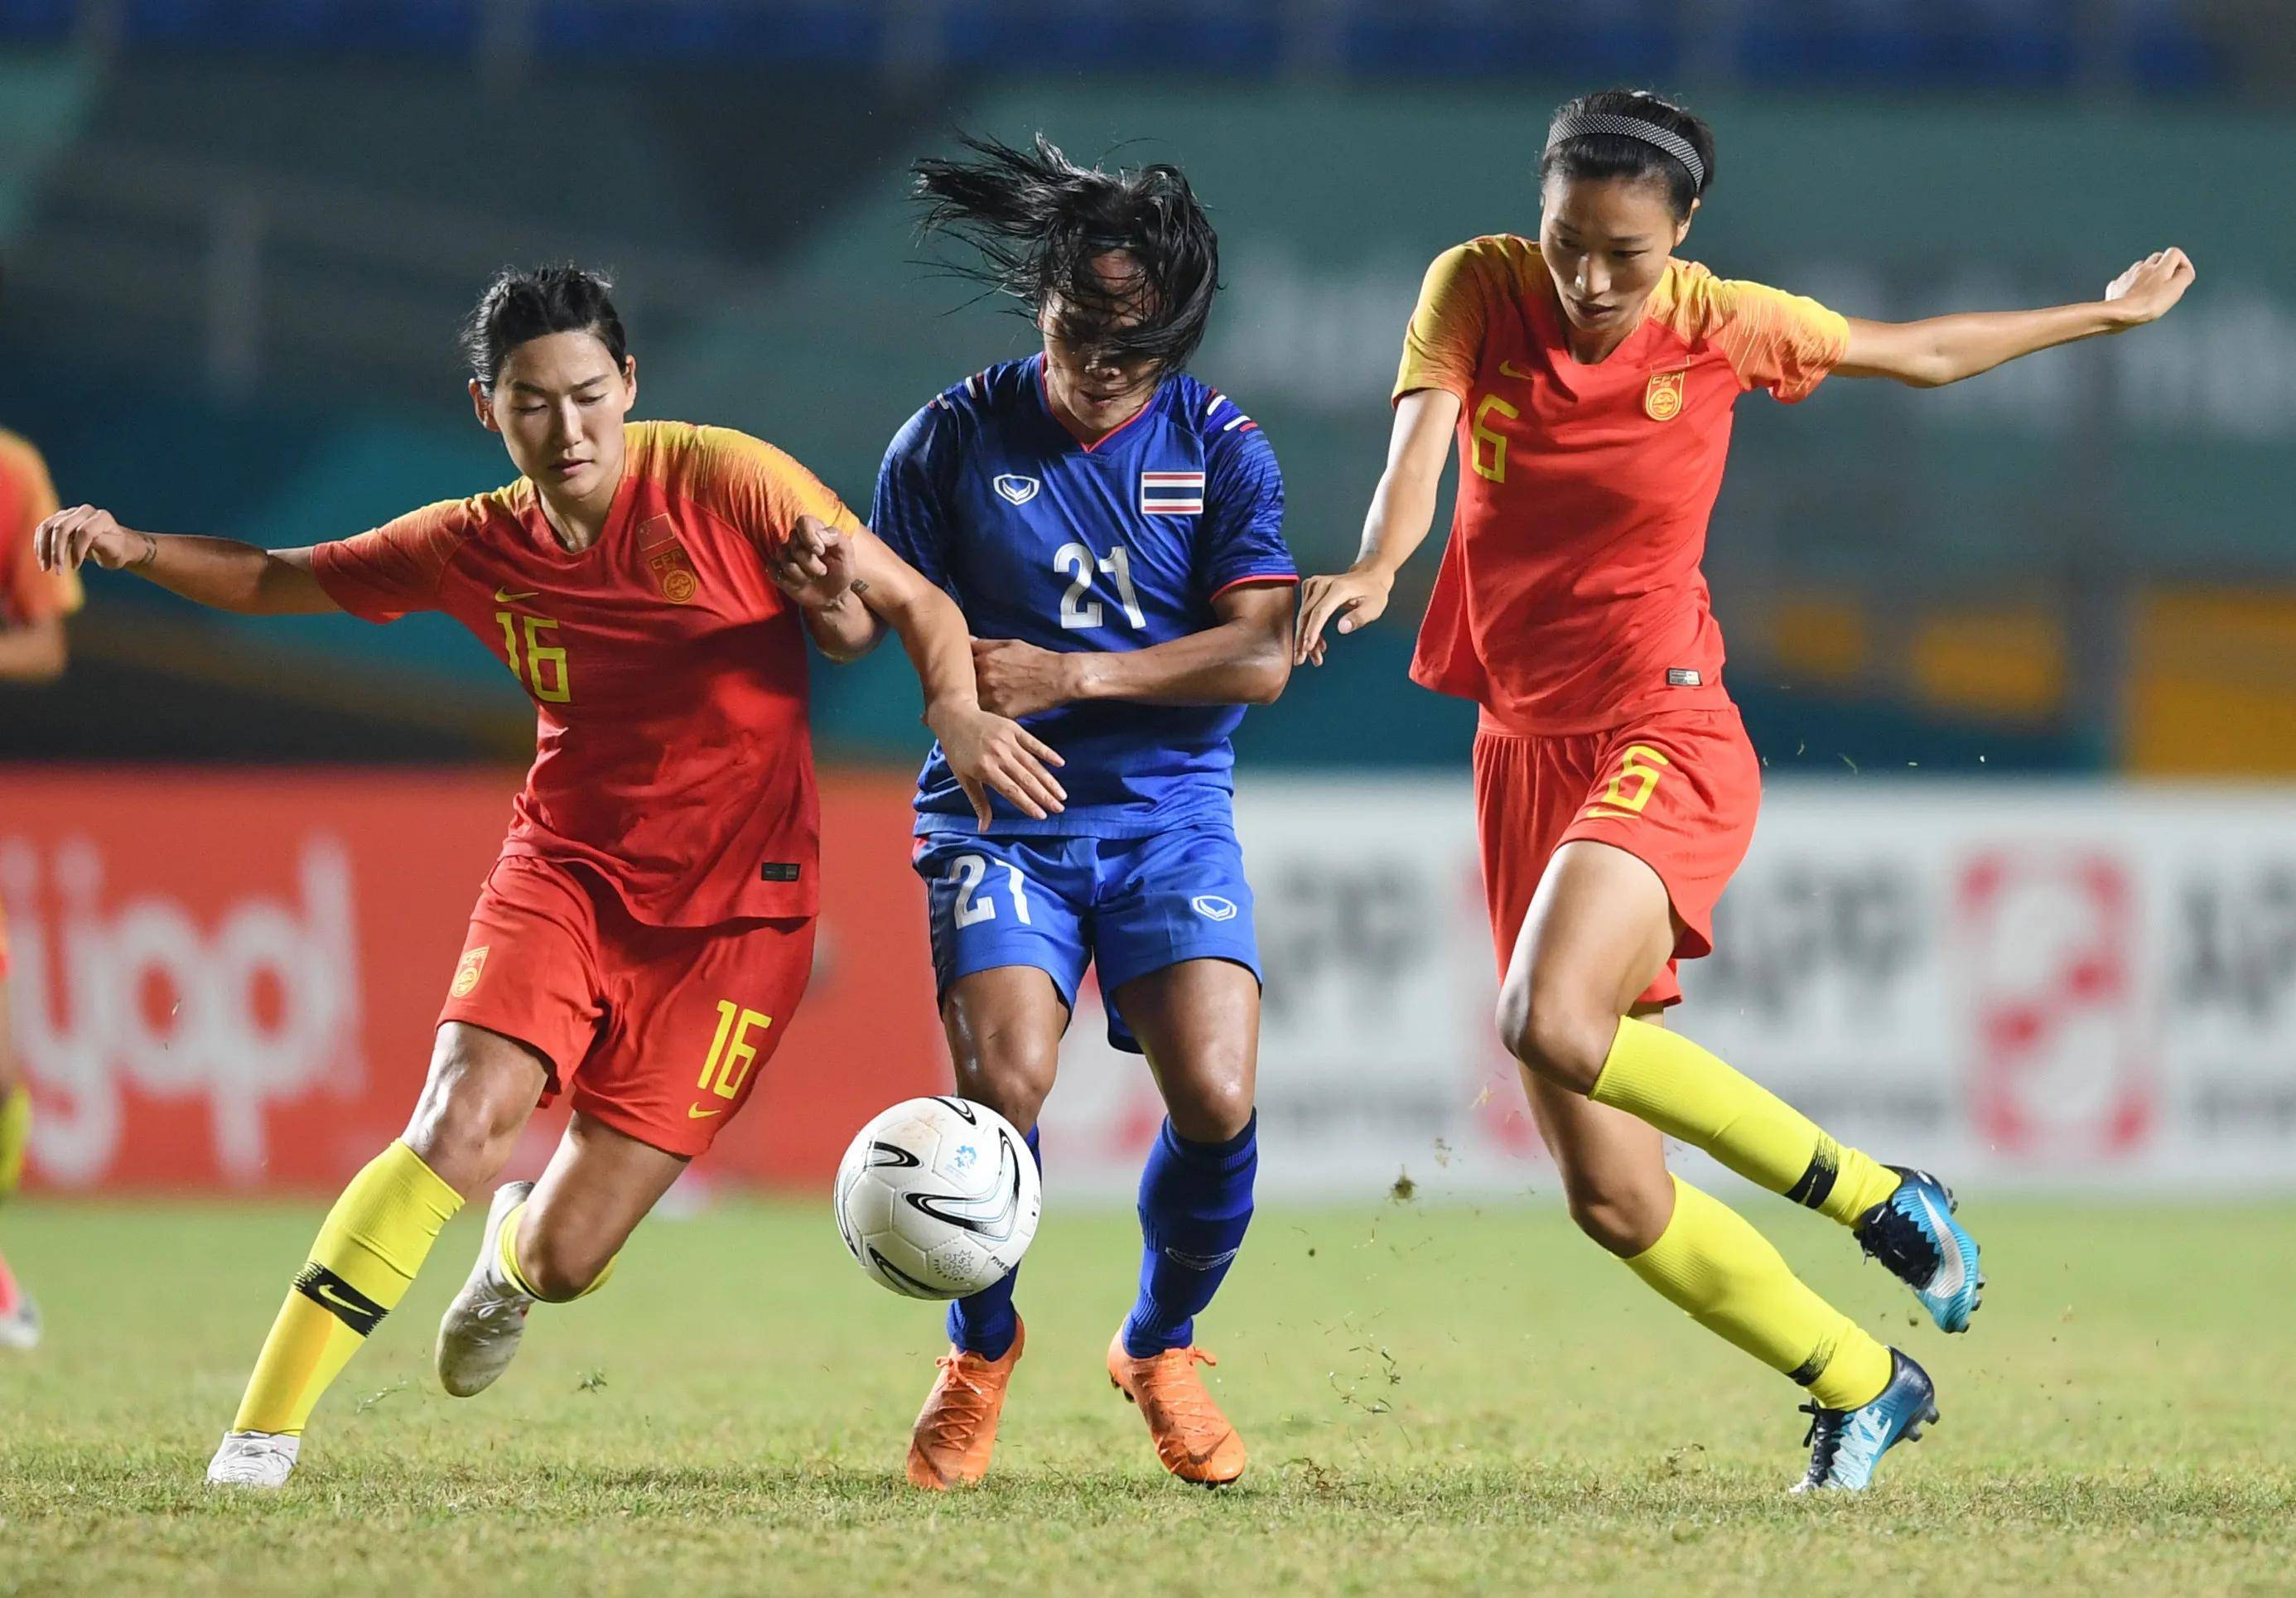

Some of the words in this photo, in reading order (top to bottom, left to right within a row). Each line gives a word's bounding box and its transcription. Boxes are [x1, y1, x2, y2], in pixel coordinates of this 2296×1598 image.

[1471, 393, 1521, 484] 6
[1053, 542, 1146, 630] 21
[495, 611, 572, 703] 16
[1601, 745, 1670, 813] 6
[948, 854, 1032, 930] 21
[697, 999, 773, 1100] 16
